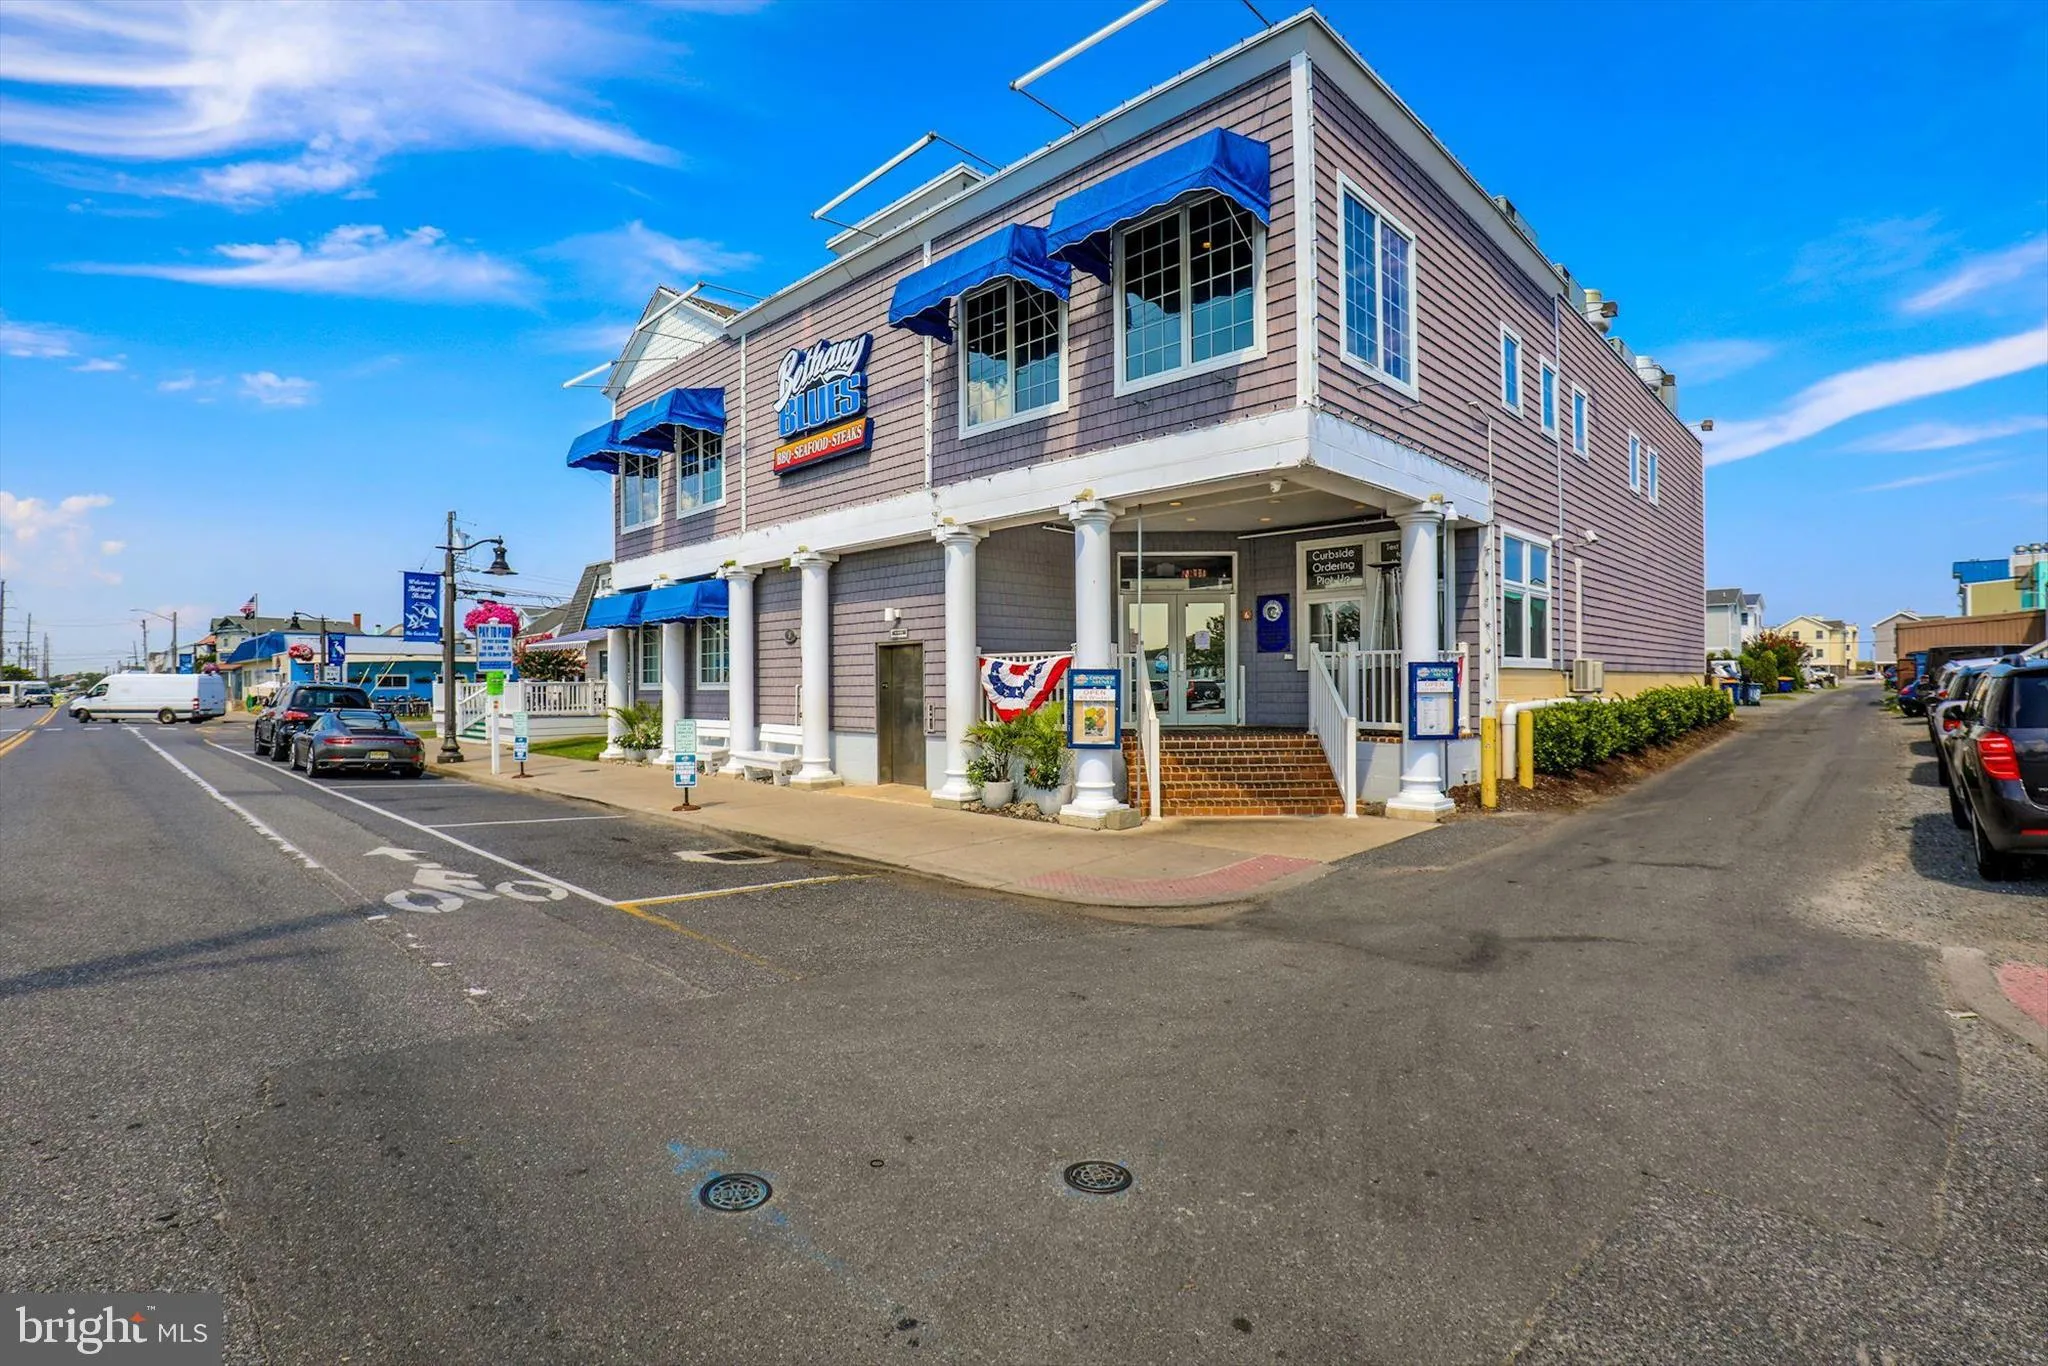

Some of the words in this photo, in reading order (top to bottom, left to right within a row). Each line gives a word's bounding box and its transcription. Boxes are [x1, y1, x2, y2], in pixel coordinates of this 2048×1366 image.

[773, 334, 866, 412] Bethany
[779, 374, 860, 437] BLUES
[794, 437, 828, 459] SEAFOOD
[832, 425, 862, 446] STEAKS
[1312, 548, 1355, 560] Curbside
[1312, 561, 1355, 573] Ordering
